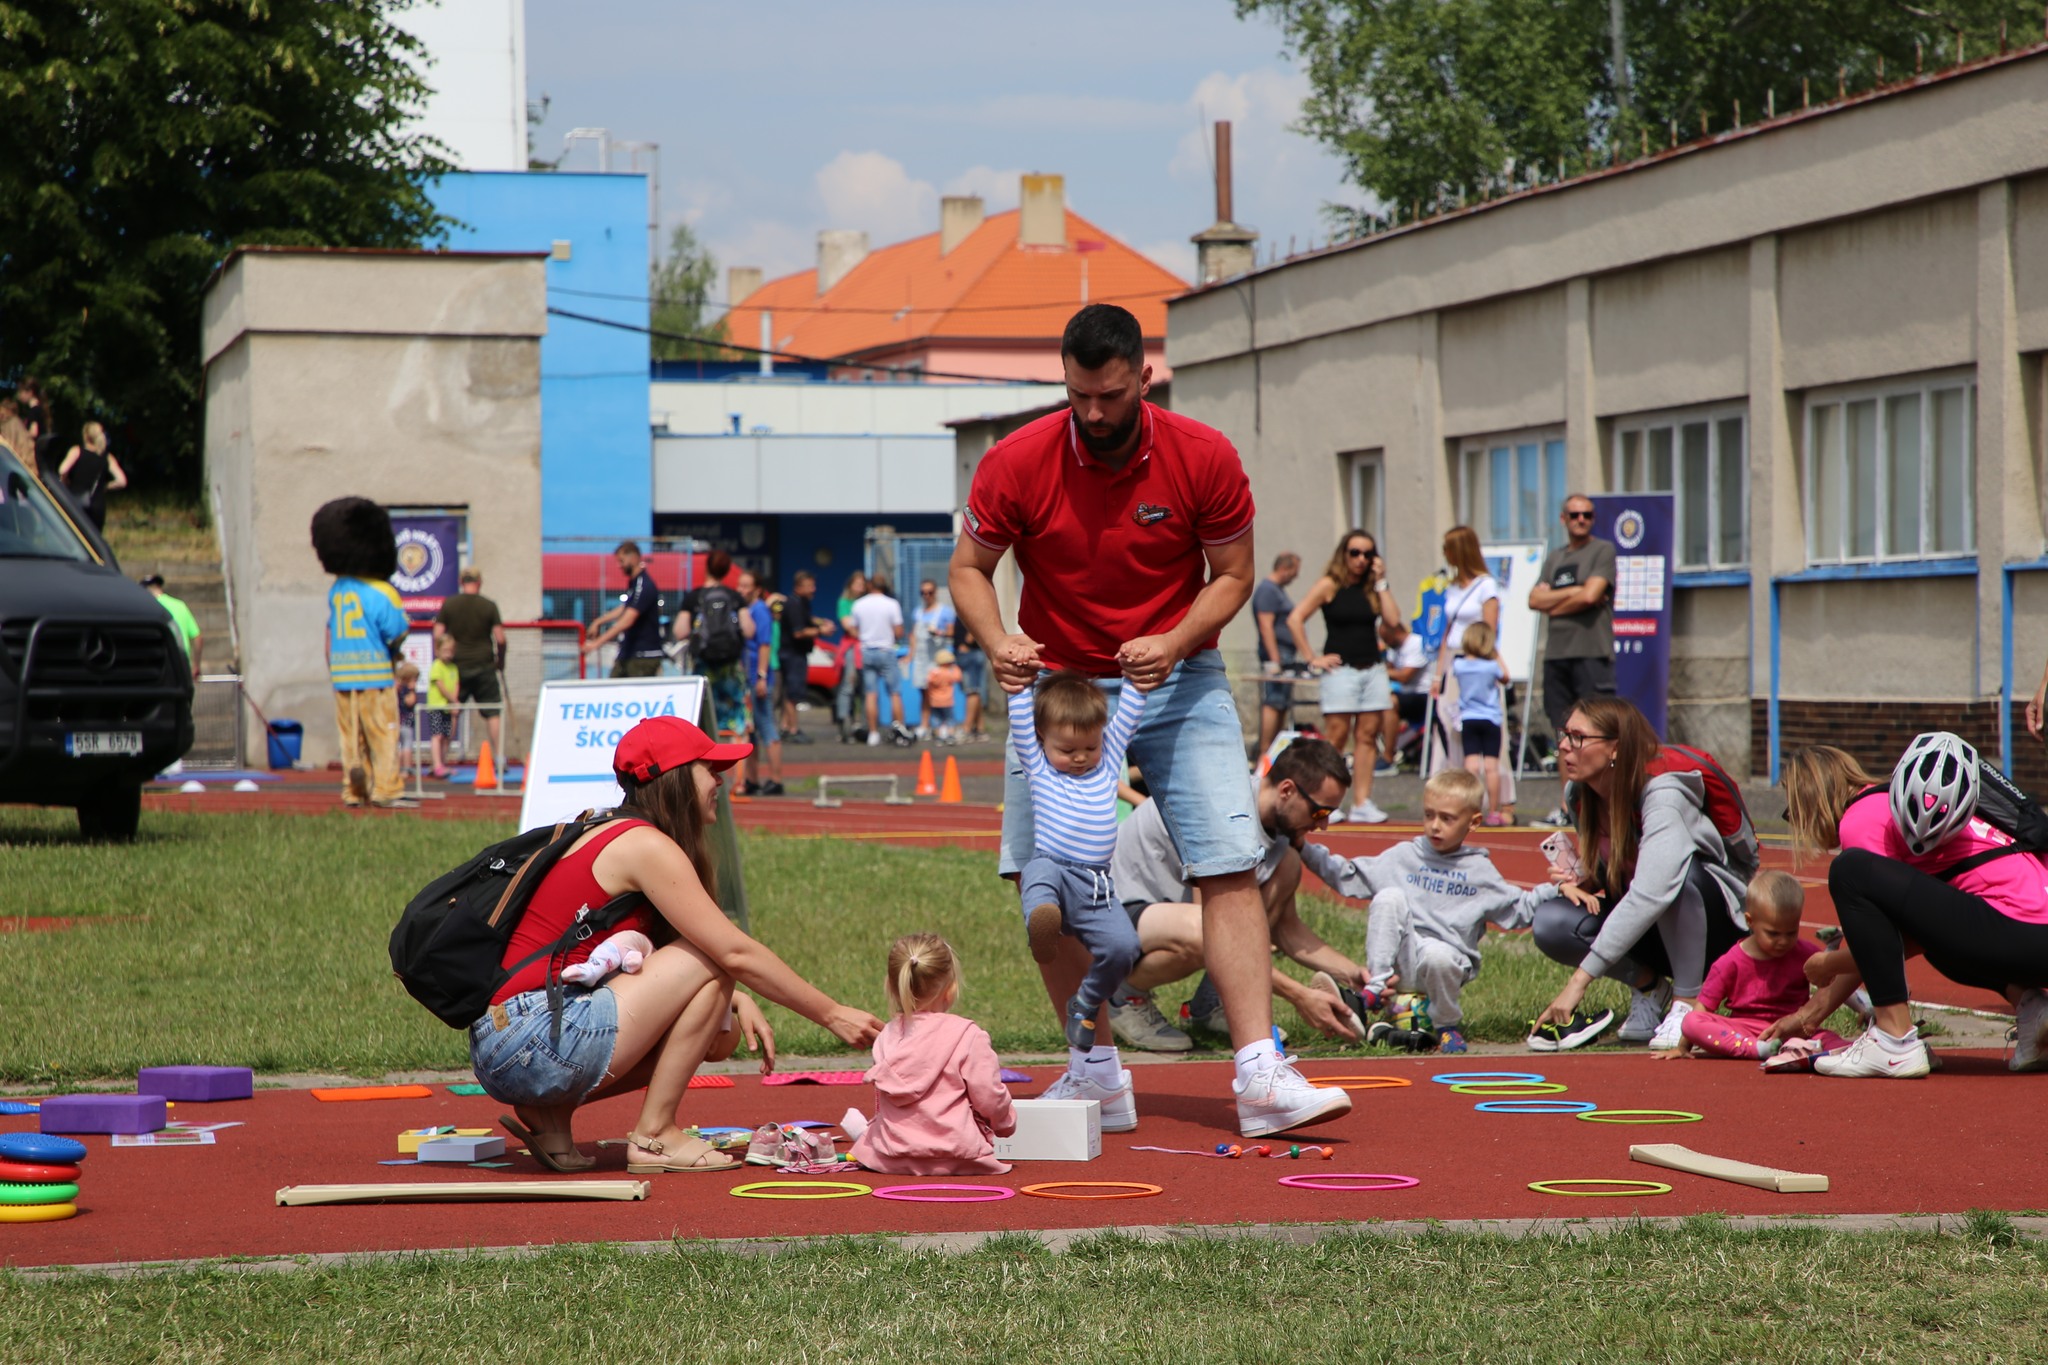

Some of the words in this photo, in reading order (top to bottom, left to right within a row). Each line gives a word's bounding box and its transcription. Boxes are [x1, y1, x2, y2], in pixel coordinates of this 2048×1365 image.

[333, 591, 368, 640] 12
[560, 694, 676, 720] TENISOVÁ
[1407, 874, 1421, 886] ON
[1423, 876, 1444, 893] THE
[1446, 882, 1477, 897] ROAD
